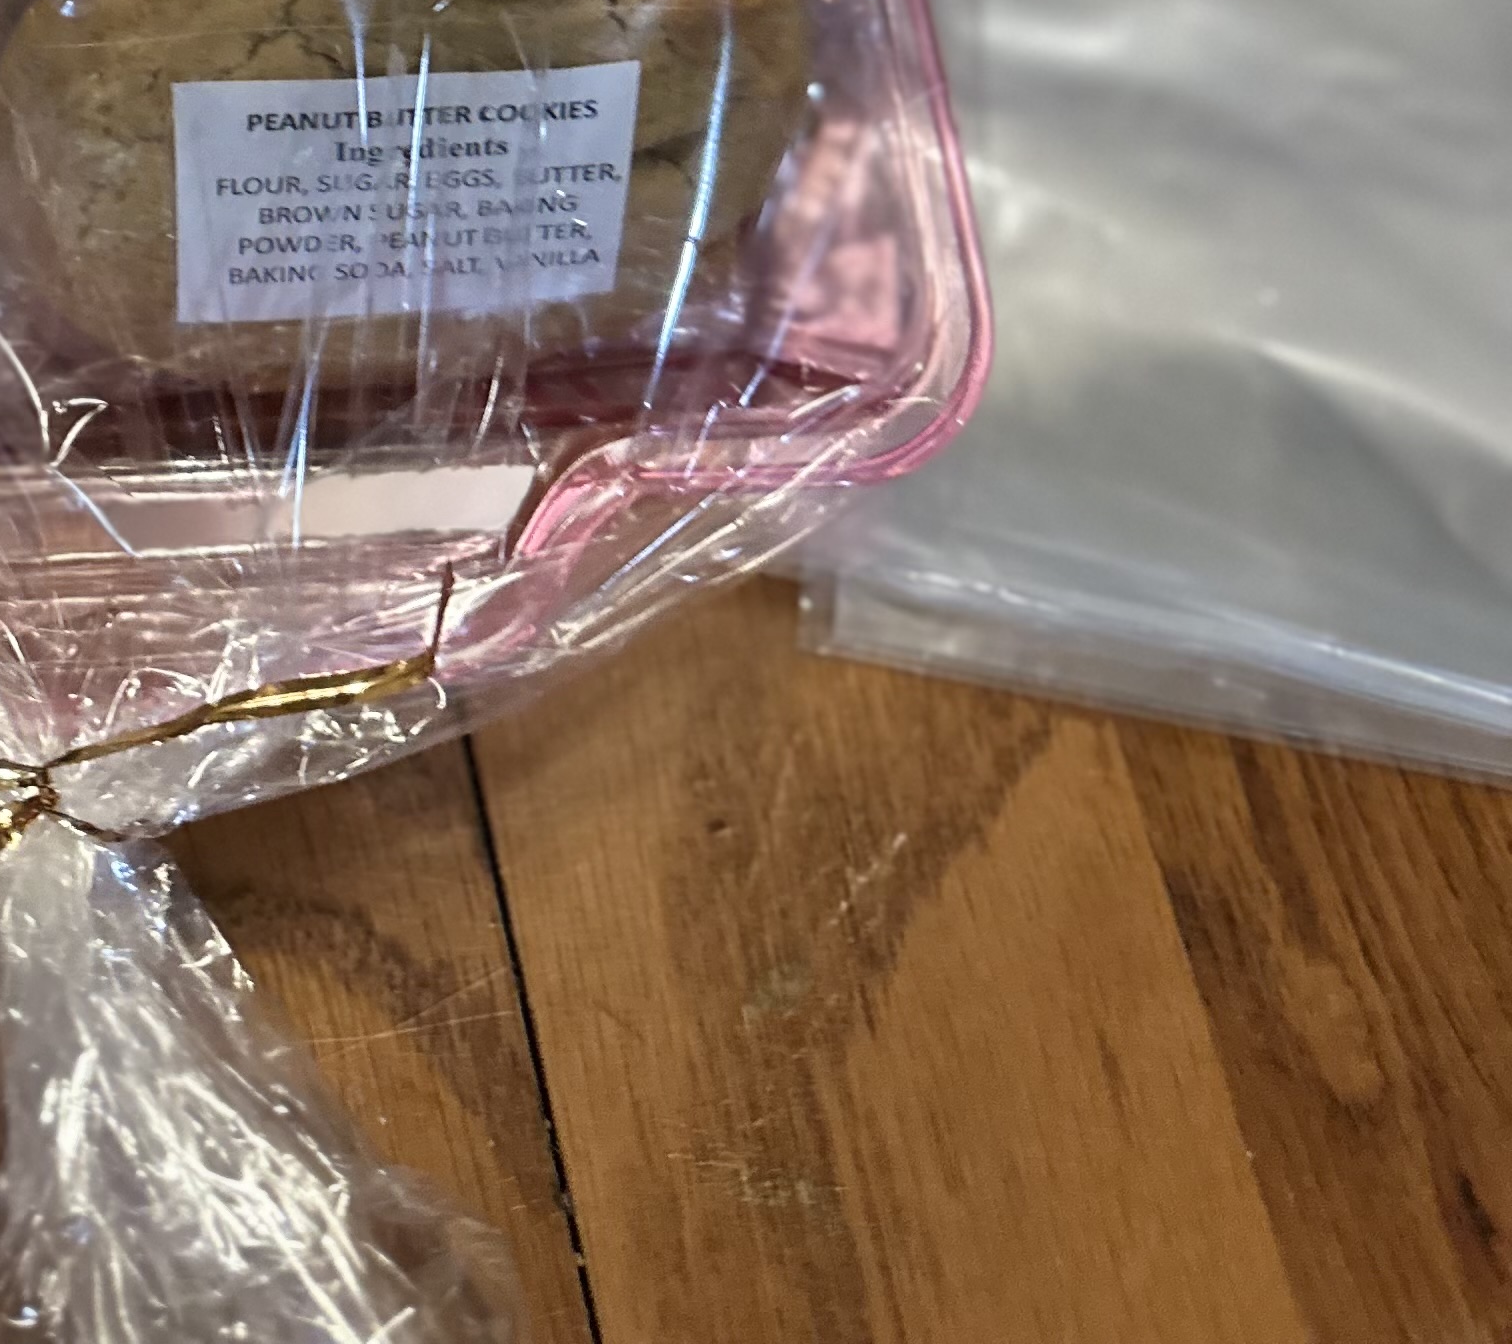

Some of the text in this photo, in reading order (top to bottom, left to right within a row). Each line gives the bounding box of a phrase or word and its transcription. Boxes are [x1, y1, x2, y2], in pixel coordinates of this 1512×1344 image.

[246, 110, 359, 131] PEANUT
[478, 100, 599, 123] COOKIES
[216, 175, 309, 196] FLOUR,
[515, 163, 622, 186] UTTER,
[259, 204, 362, 225] BROWN
[477, 194, 579, 217] BANG
[239, 234, 362, 254] POWDER,
[483, 223, 592, 247] BTER,
[424, 257, 486, 278] ALT,
